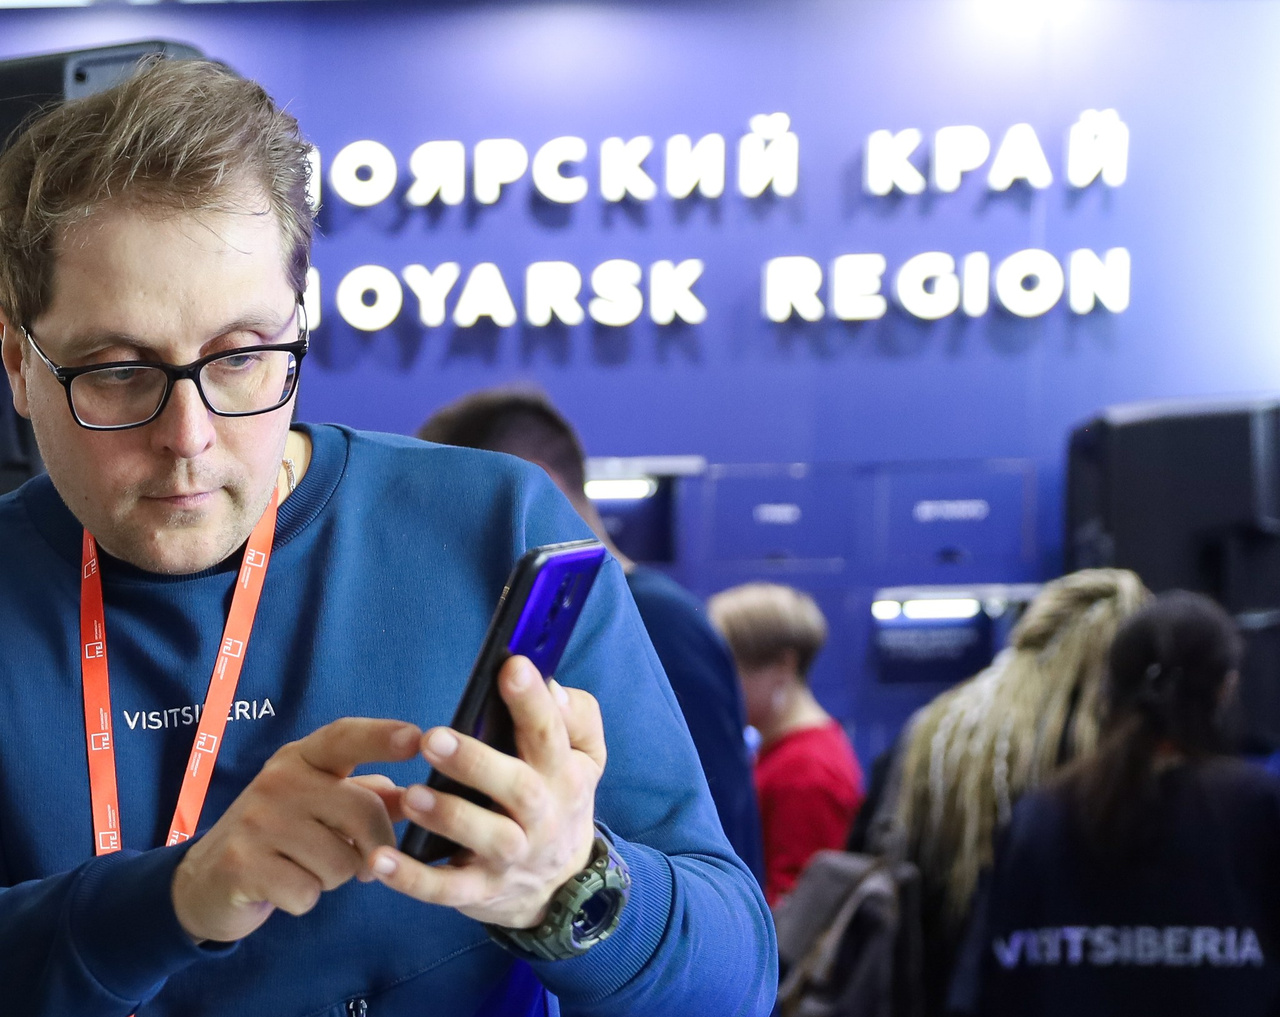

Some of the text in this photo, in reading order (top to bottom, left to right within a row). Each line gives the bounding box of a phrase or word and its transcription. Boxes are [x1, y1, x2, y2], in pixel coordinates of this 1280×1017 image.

[303, 108, 1130, 207] ОЯРСКИЙ КРАЙ
[301, 246, 1131, 331] OYARSK REGION
